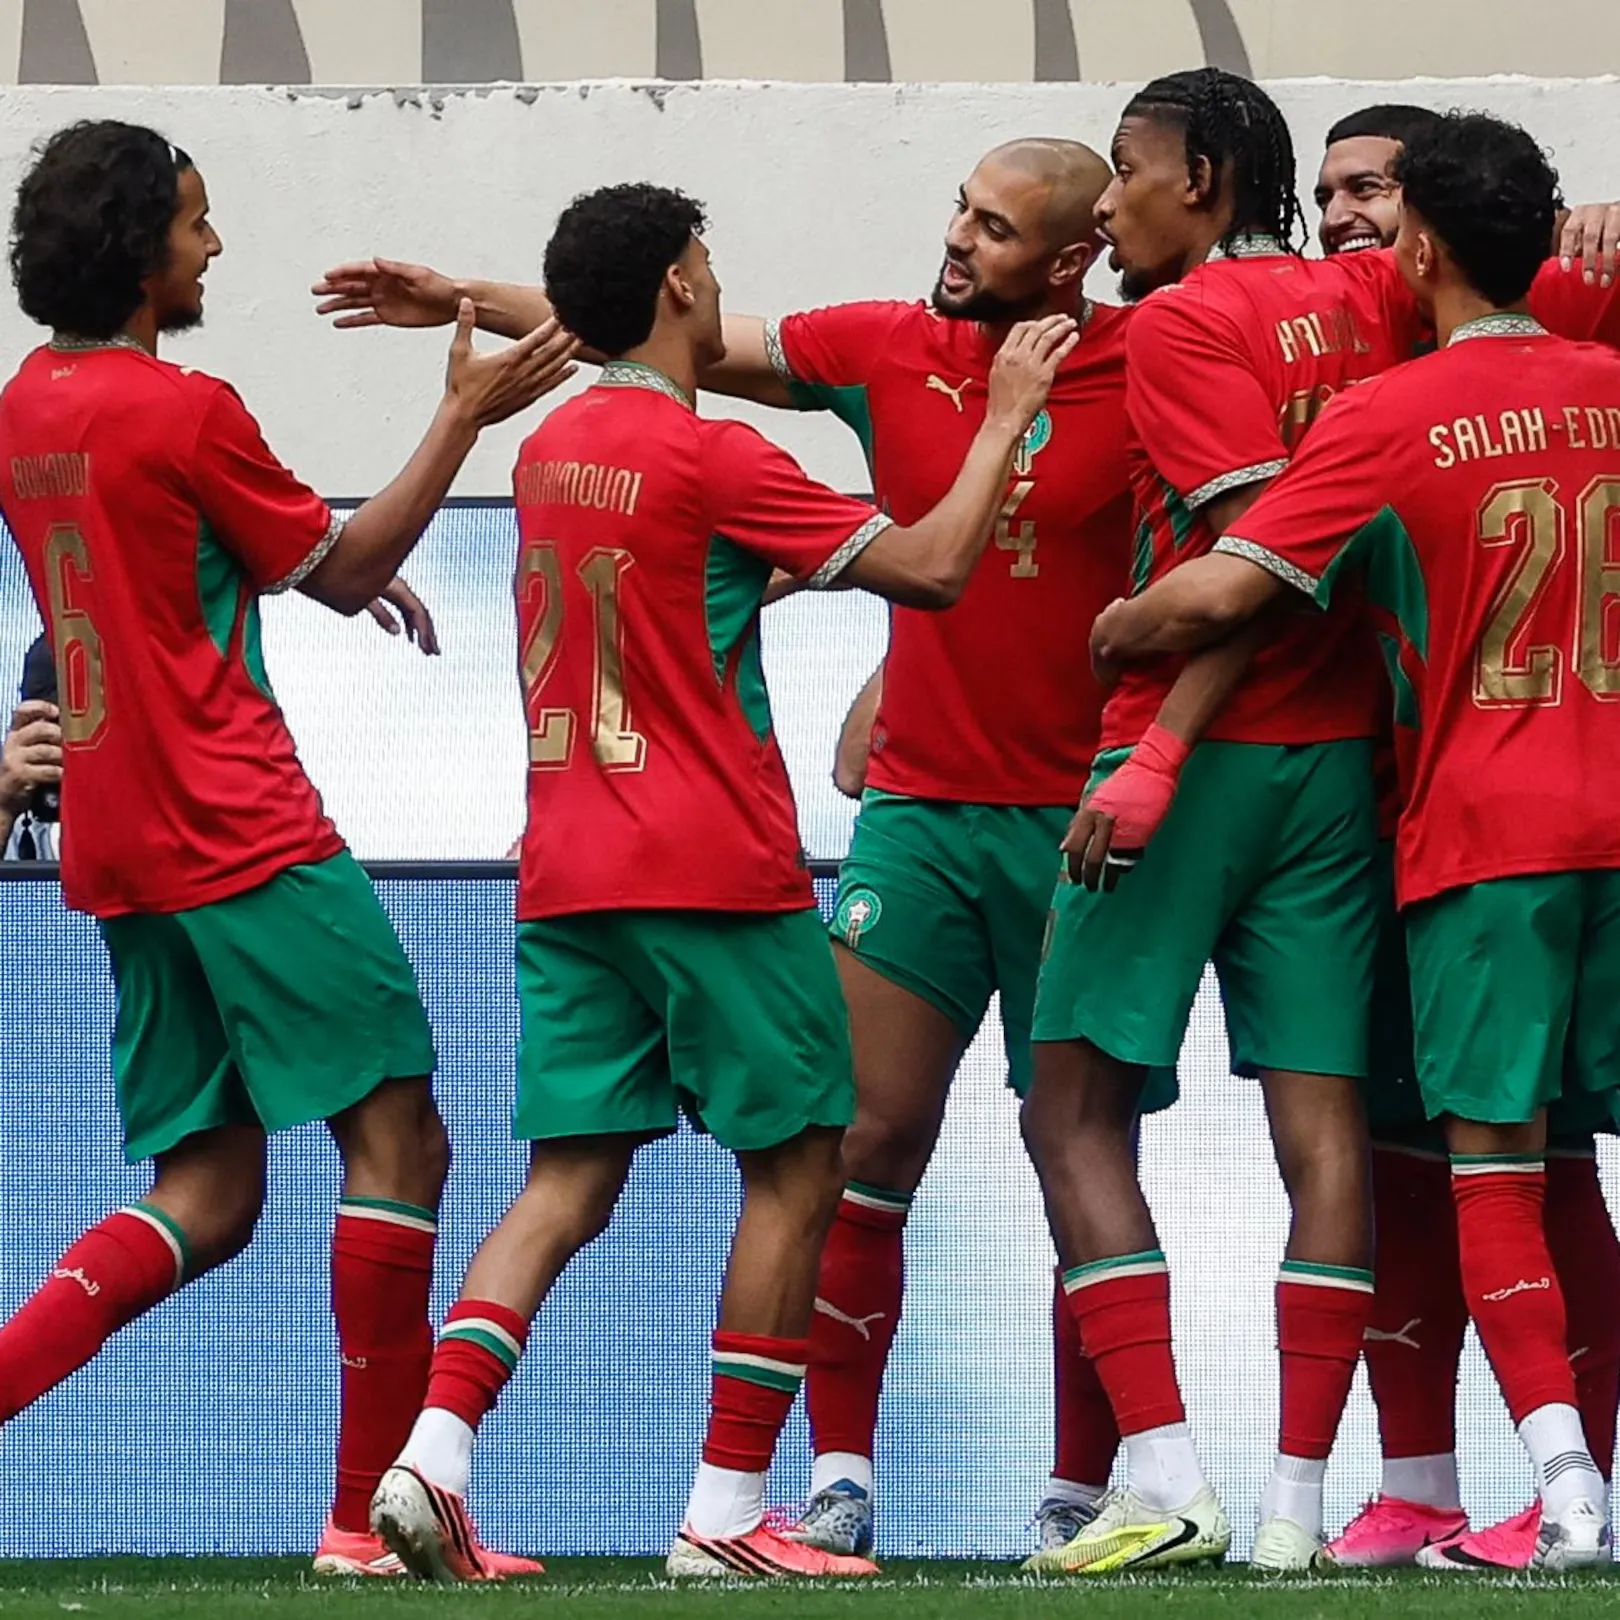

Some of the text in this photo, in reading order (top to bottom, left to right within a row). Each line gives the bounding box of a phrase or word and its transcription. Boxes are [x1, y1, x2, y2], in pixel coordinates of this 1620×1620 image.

[1275, 312, 1371, 363] HALL
[994, 481, 1040, 578] 4
[43, 521, 110, 752] 6
[518, 539, 648, 773] 21
